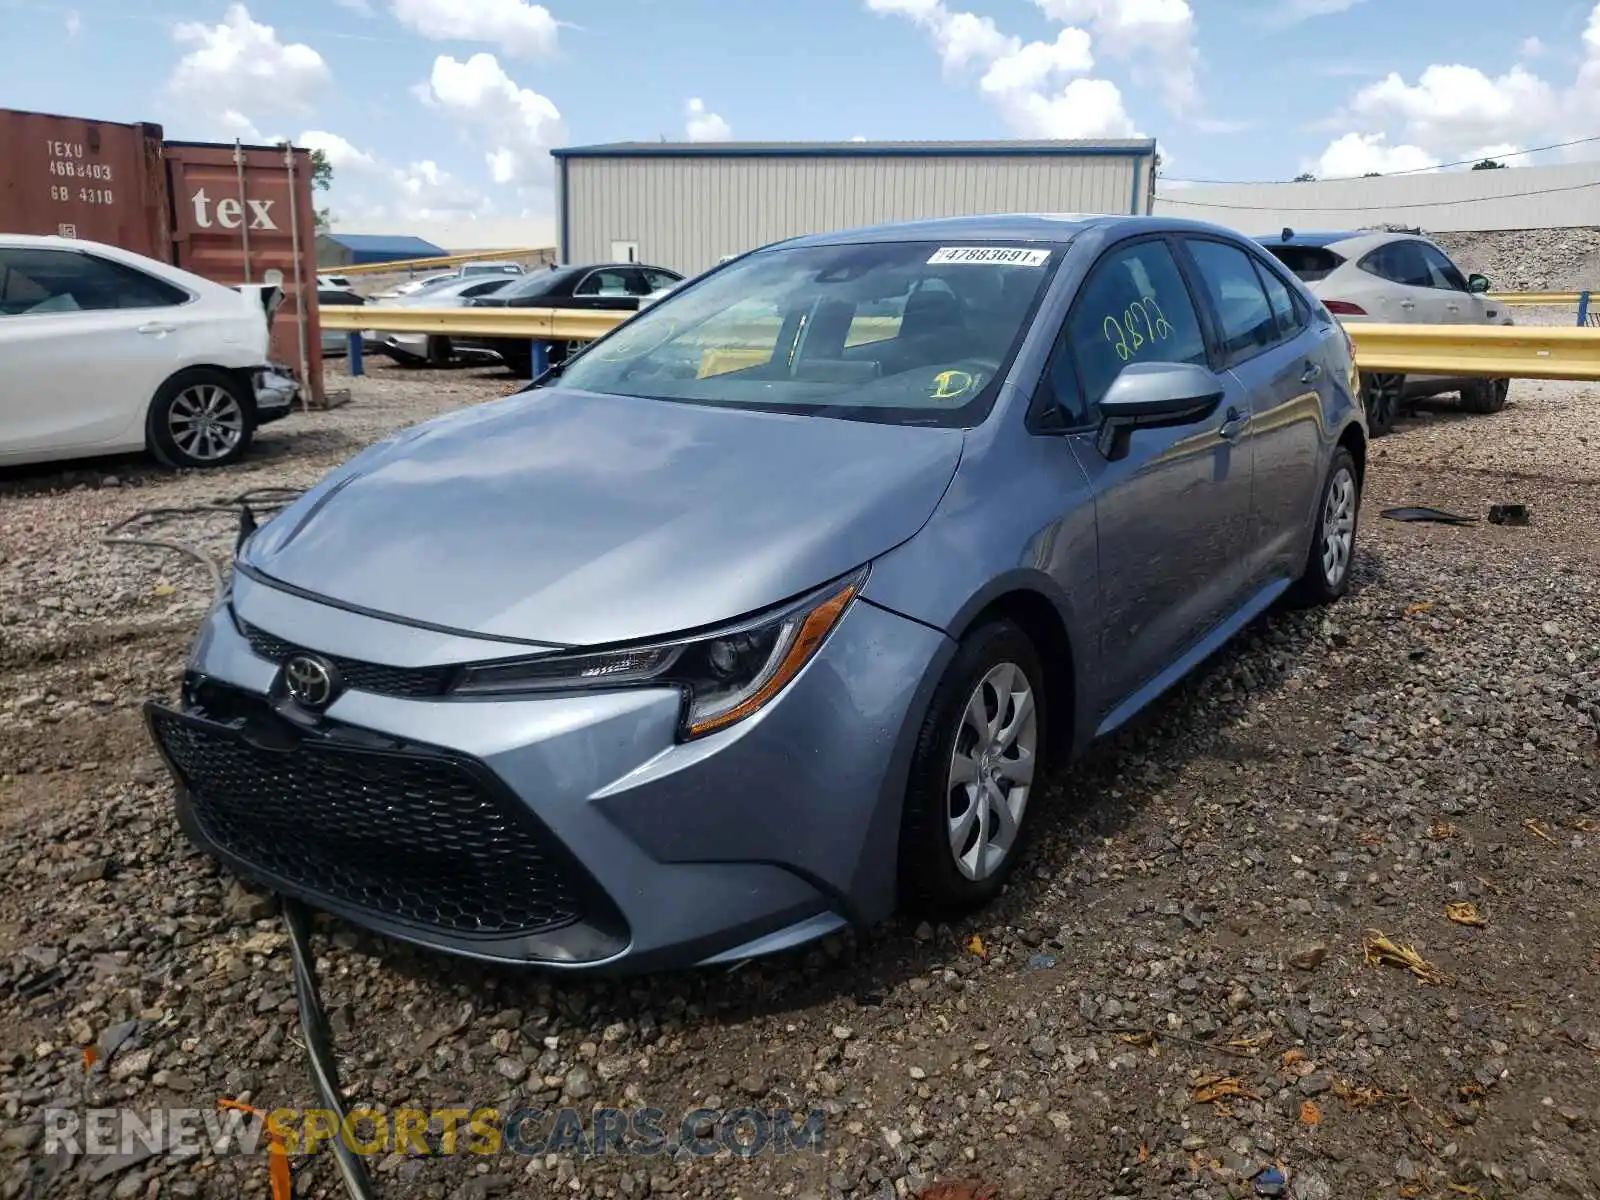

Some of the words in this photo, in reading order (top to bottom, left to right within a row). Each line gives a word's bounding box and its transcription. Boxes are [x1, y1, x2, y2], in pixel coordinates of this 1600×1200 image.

[47, 140, 83, 158] TEXU
[192, 188, 278, 229] tex
[1104, 297, 1175, 360] 2872
